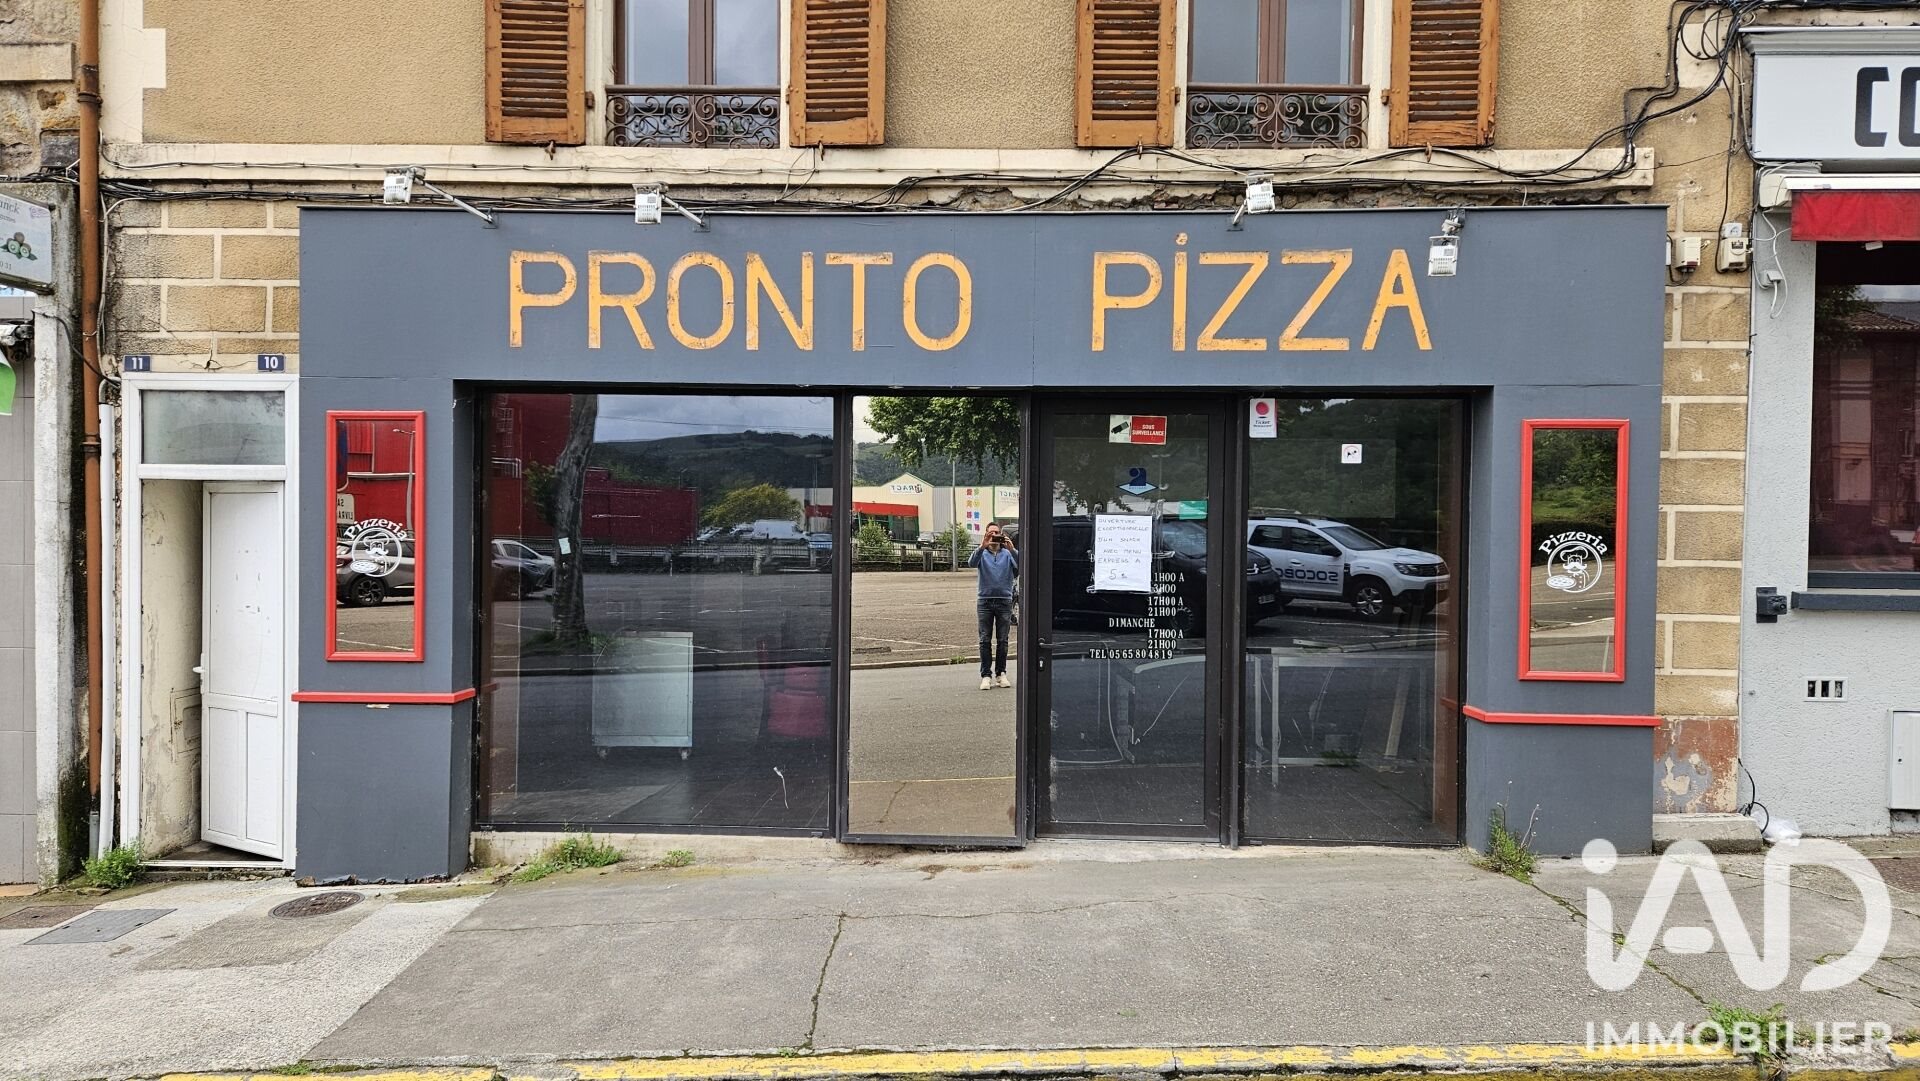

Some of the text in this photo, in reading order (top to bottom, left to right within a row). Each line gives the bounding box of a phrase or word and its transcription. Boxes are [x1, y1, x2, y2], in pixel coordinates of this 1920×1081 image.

[509, 249, 972, 351] PRONTO
[131, 357, 143, 370] 11
[264, 356, 279, 369] 10
[343, 518, 408, 541] Pizzeria
[1538, 531, 1608, 555] Pizzeria
[1108, 568, 1117, 580] 5
[1178, 572, 1185, 582] A
[1148, 596, 1184, 606] 17H00 A
[1147, 607, 1177, 617] 21H00
[1108, 617, 1156, 628] DIMANCHE
[1148, 629, 1184, 639] 17H00 A
[1147, 640, 1177, 649] 21H00
[1090, 649, 1107, 659] TEL
